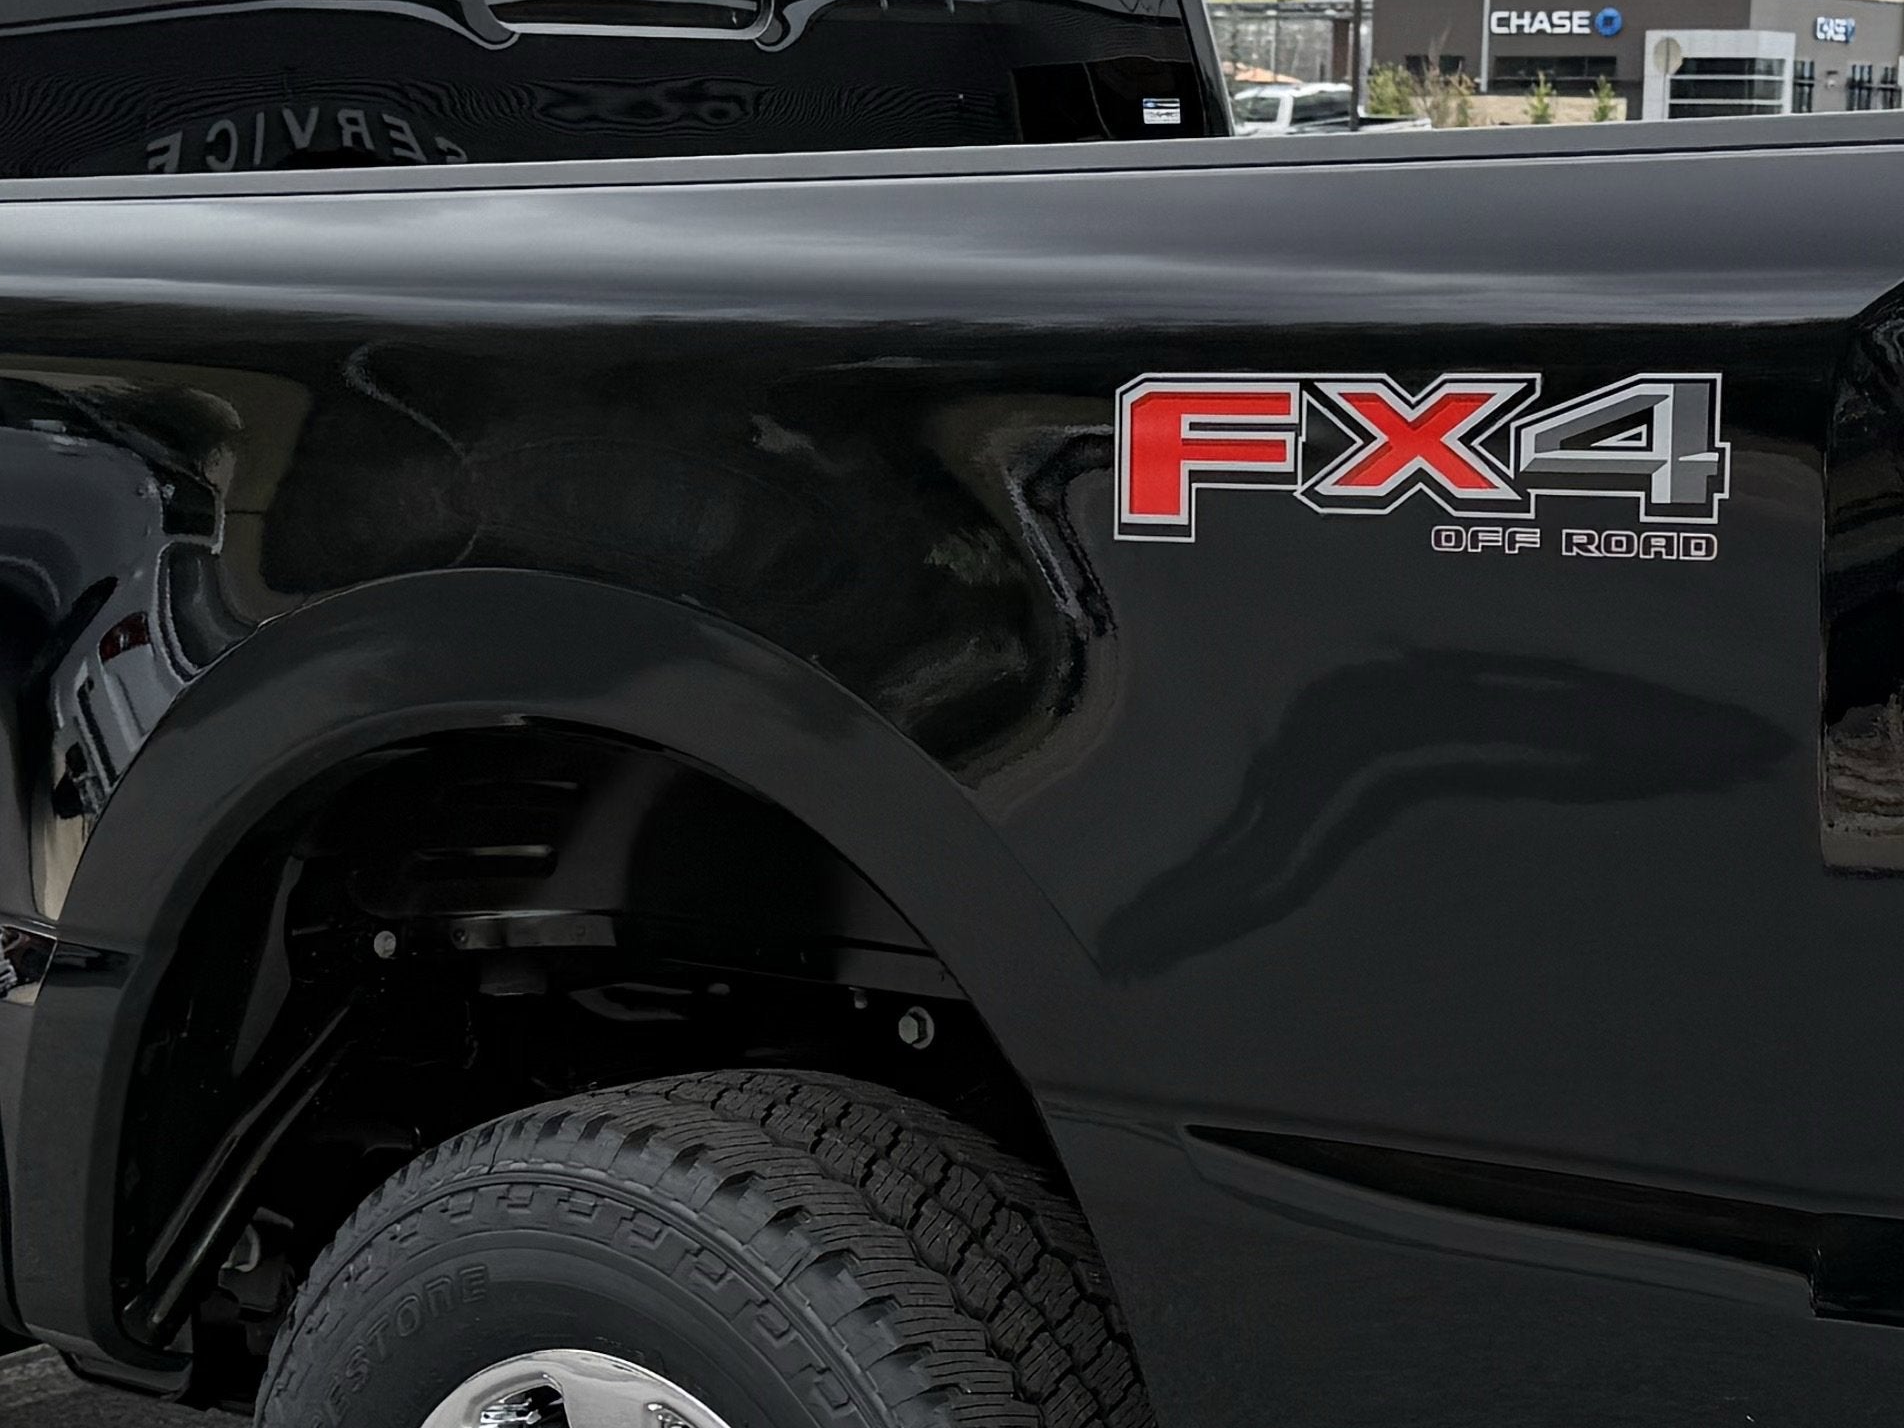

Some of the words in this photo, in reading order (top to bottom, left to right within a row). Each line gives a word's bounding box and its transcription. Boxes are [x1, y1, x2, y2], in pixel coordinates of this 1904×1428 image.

[1490, 10, 1592, 34] CHASE
[1114, 373, 1730, 541] FX4
[1431, 525, 1541, 555] OFF
[1561, 528, 1718, 561] ROAD
